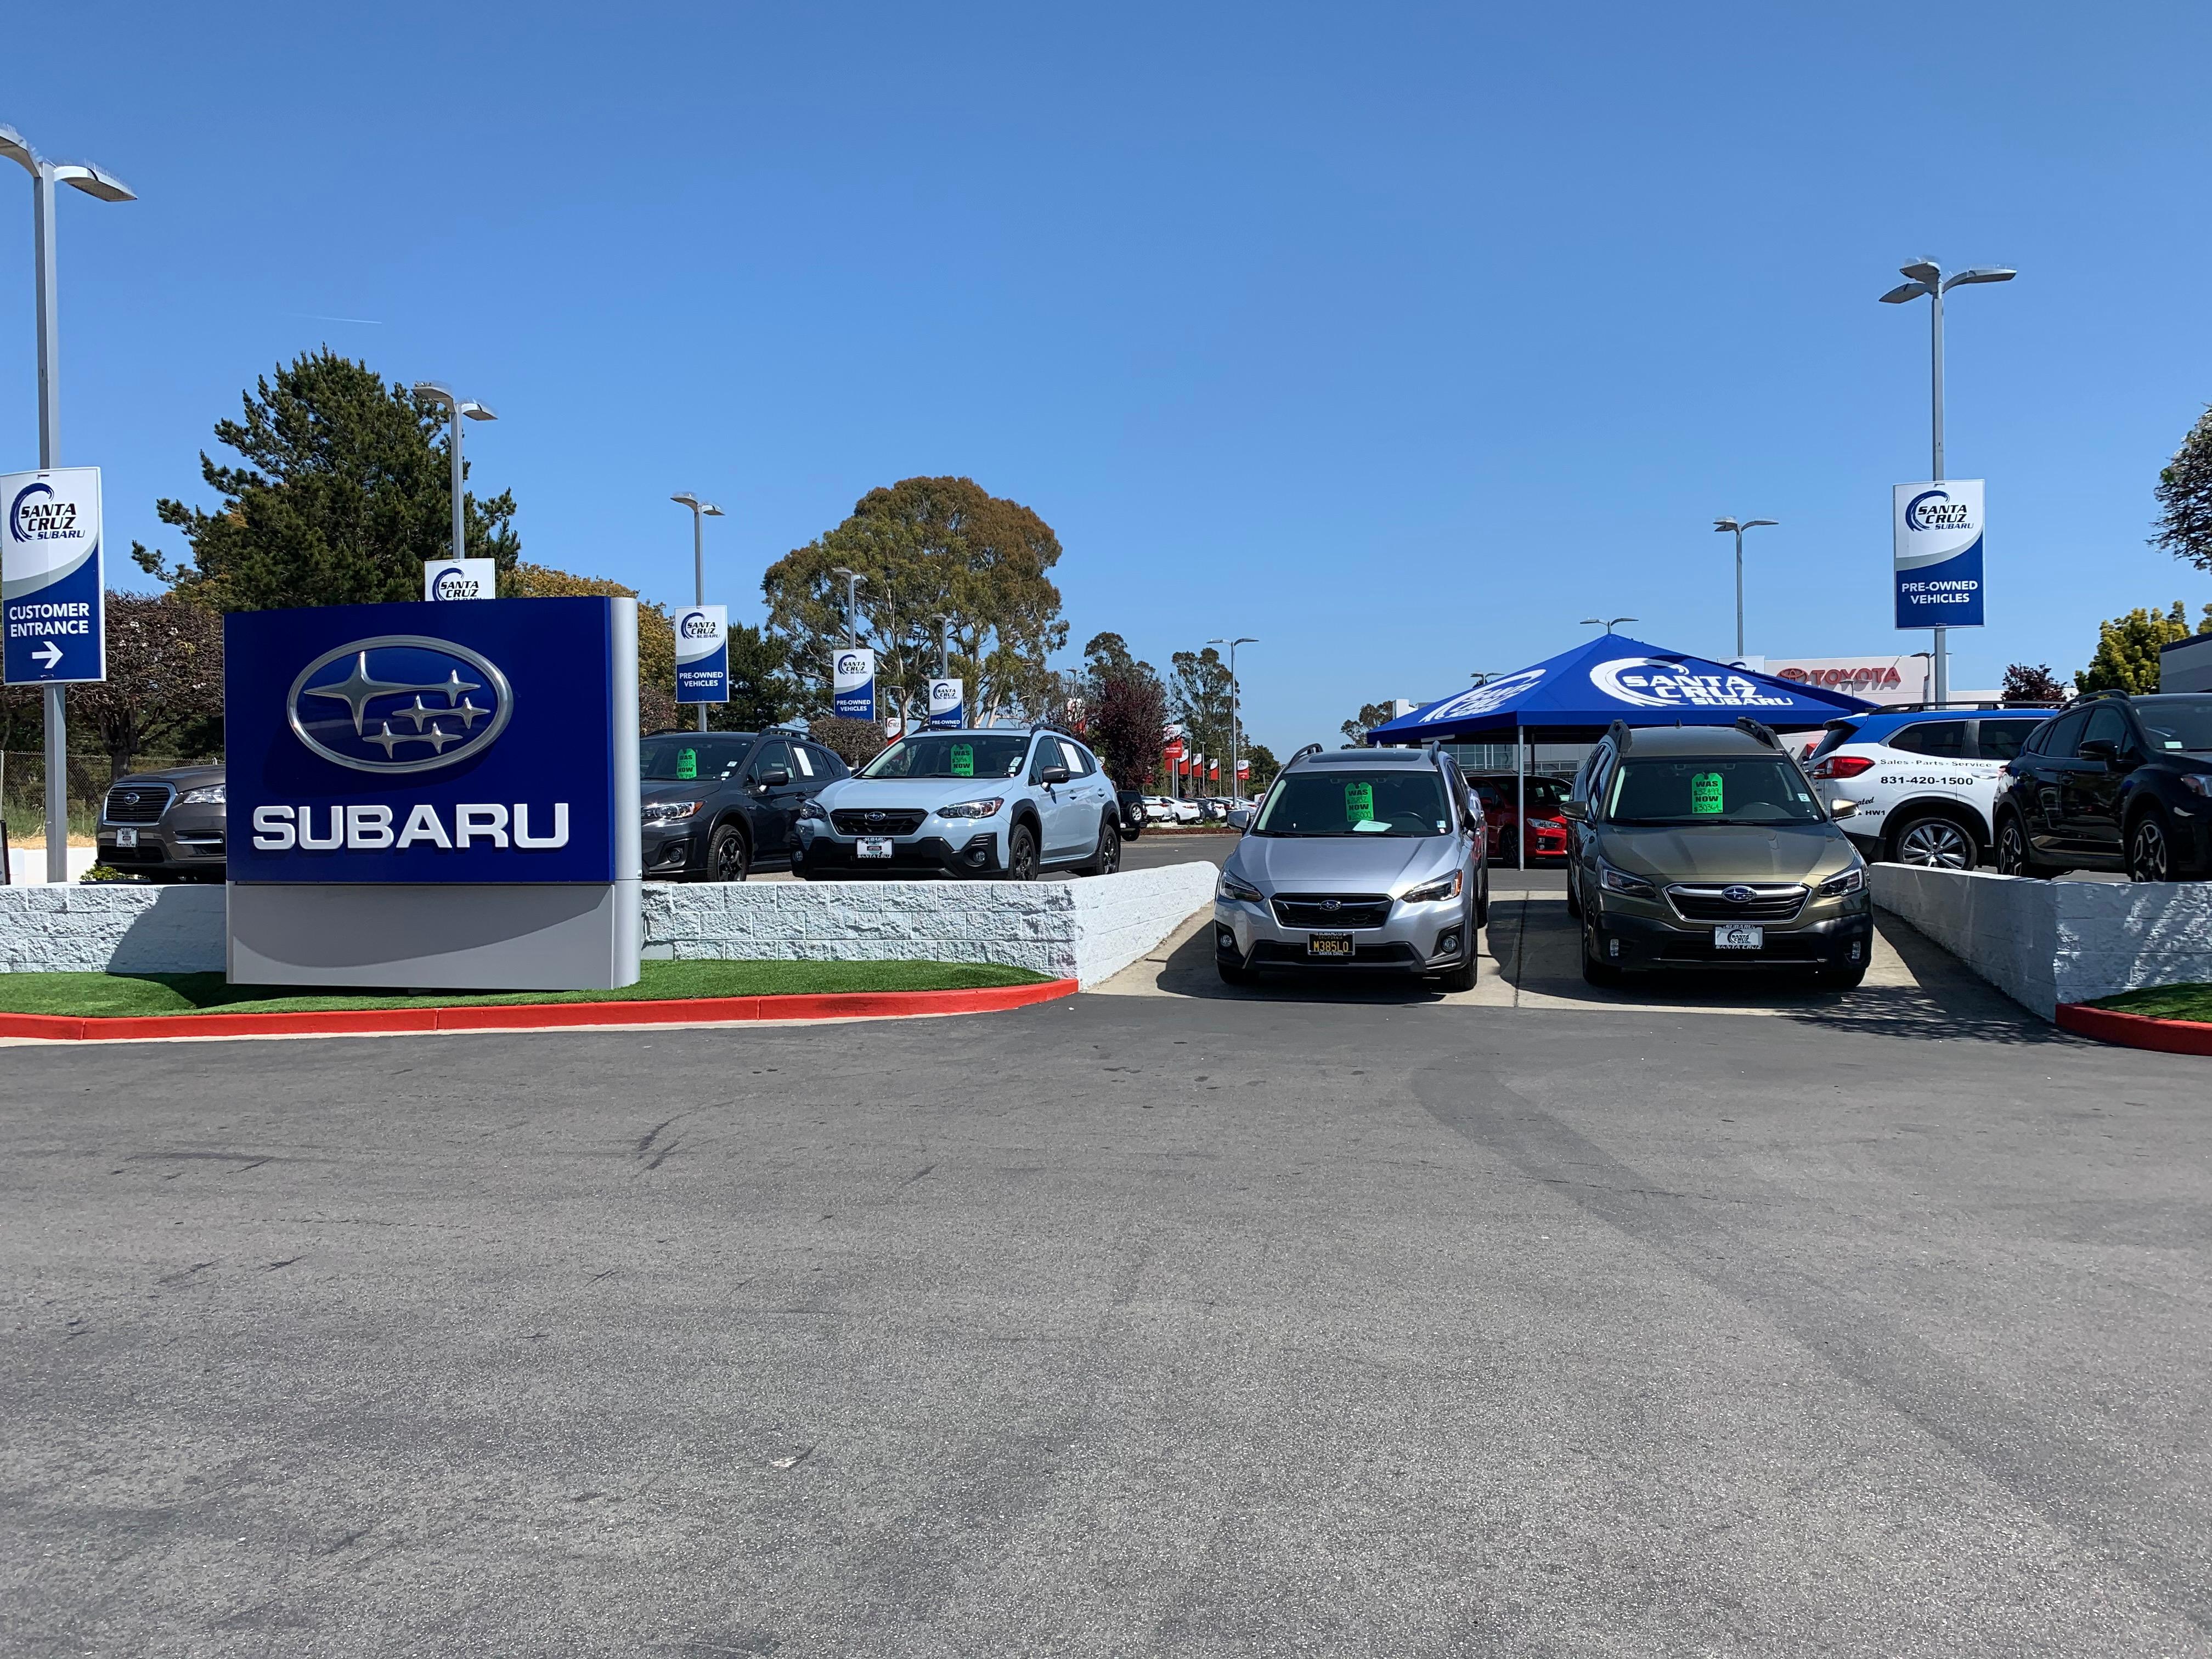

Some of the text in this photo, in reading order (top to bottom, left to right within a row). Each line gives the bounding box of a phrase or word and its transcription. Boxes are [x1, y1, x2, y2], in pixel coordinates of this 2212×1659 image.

[21, 503, 77, 518] SANTA
[1917, 504, 1967, 515] SANTA
[28, 517, 76, 531] CRUZ
[1925, 514, 1967, 524] CRUZ
[37, 530, 85, 540] SUBARU
[441, 581, 479, 590] SANTA
[1901, 580, 1978, 592] PRE-OWNED
[445, 589, 479, 598] CRUZ
[1910, 593, 1970, 604] VEHICLES
[9, 603, 90, 620] CUSTOMER
[10, 620, 89, 637] ENTRANCE
[1622, 675, 1754, 686] SANTA
[1812, 667, 1901, 685] TOYOTA
[1655, 686, 1763, 698] CRUZ
[1691, 697, 1793, 706] SUBARU
[1881, 776, 1973, 785] 831-420-1500
[1857, 797, 1875, 806] ated
[253, 802, 569, 850] SUBARU
